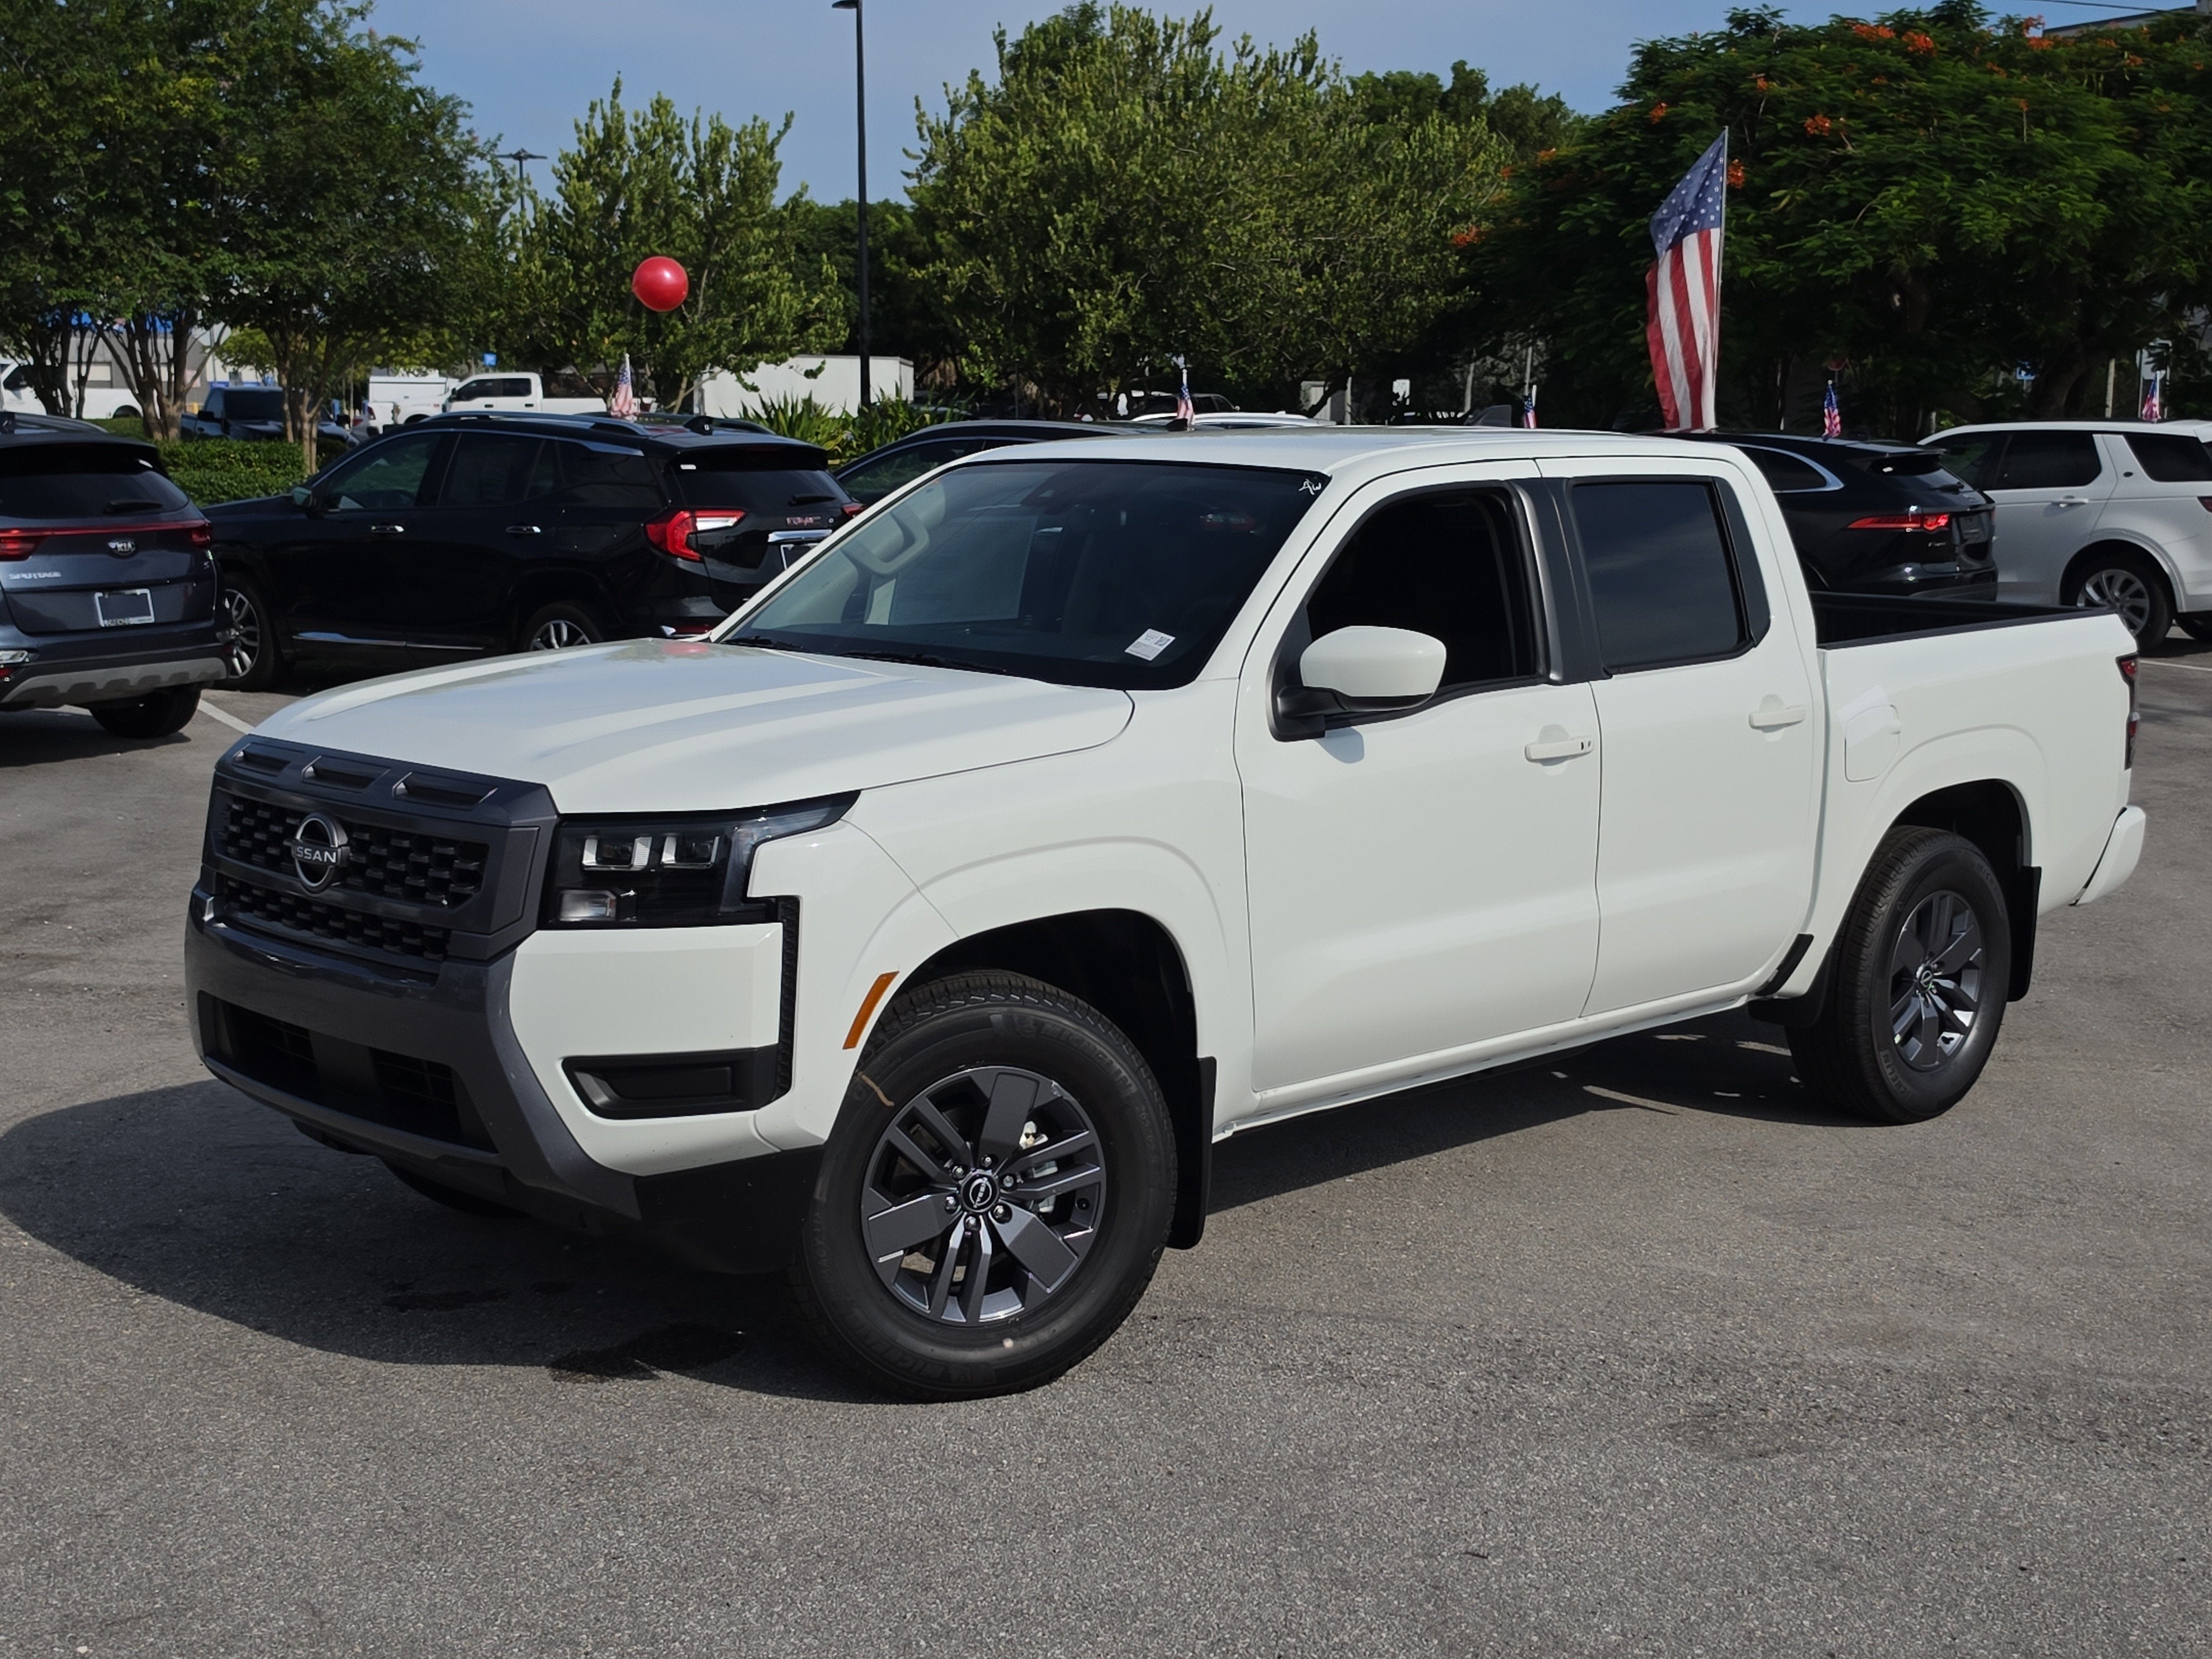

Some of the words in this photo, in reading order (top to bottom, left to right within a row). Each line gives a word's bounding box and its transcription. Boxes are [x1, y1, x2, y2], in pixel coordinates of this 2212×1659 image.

[117, 542, 133, 552] KIA
[297, 846, 336, 863] SSAN
[1882, 1053, 1913, 1099] ICHELIN
